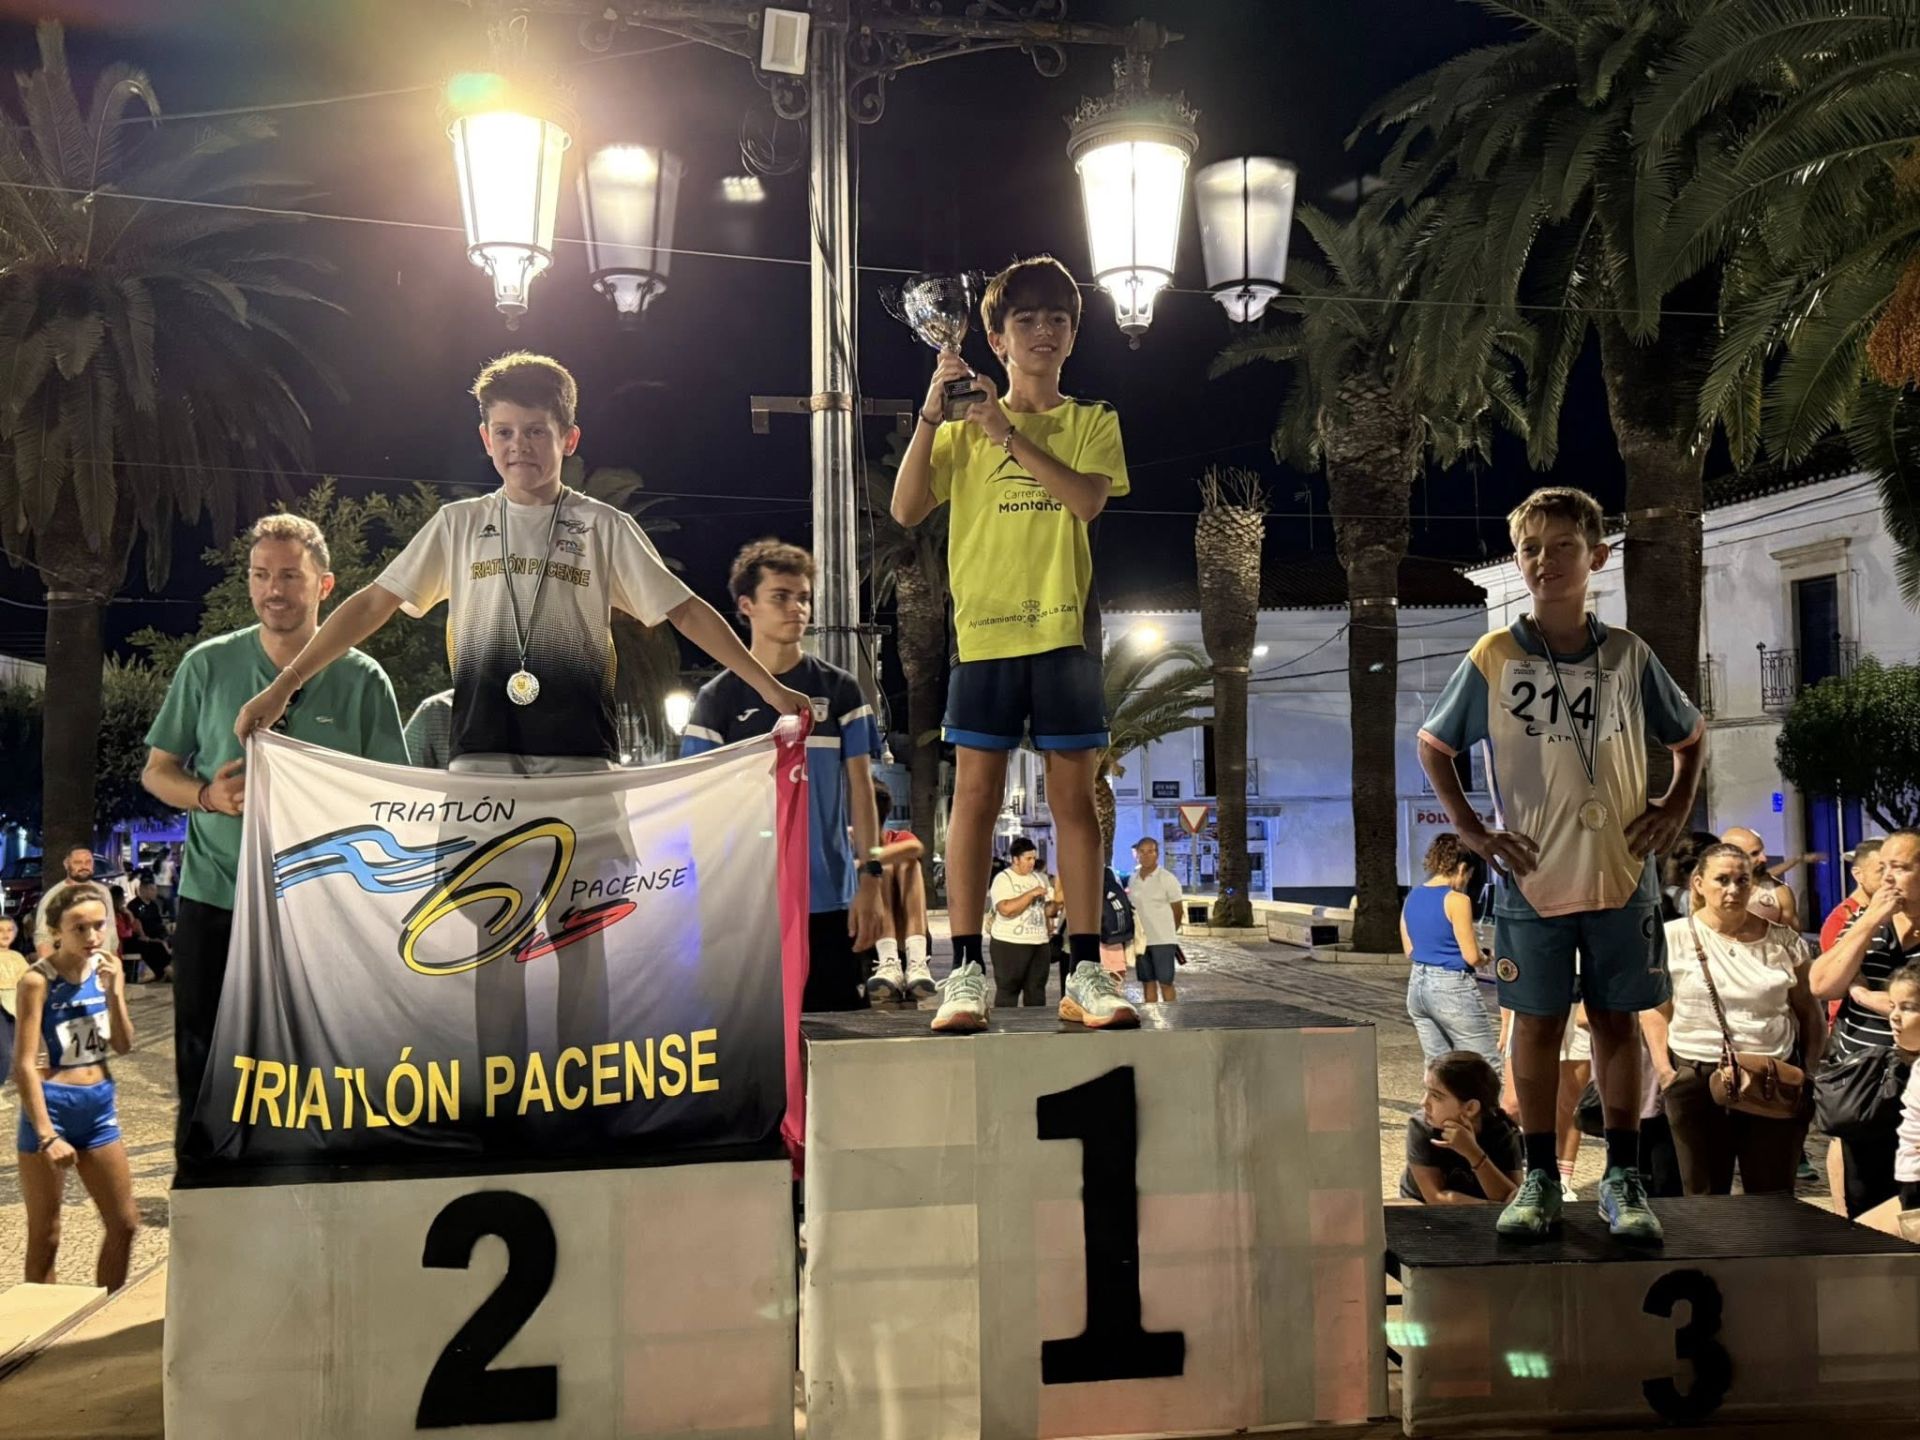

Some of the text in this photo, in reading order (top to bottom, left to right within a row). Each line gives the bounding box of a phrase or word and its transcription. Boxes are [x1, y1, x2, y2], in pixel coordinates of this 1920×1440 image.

[1004, 490, 1047, 499] Carreras
[969, 613, 1023, 629] Ayuntamiento
[1511, 681, 1595, 730] 214
[369, 798, 515, 823] TRIATLÓN
[568, 866, 689, 900] PACENSE
[230, 1028, 720, 1131] TRIATLÓN PACENSE
[1037, 1066, 1185, 1384] 1
[415, 1189, 558, 1429] 2
[1642, 1269, 1733, 1422] 3
